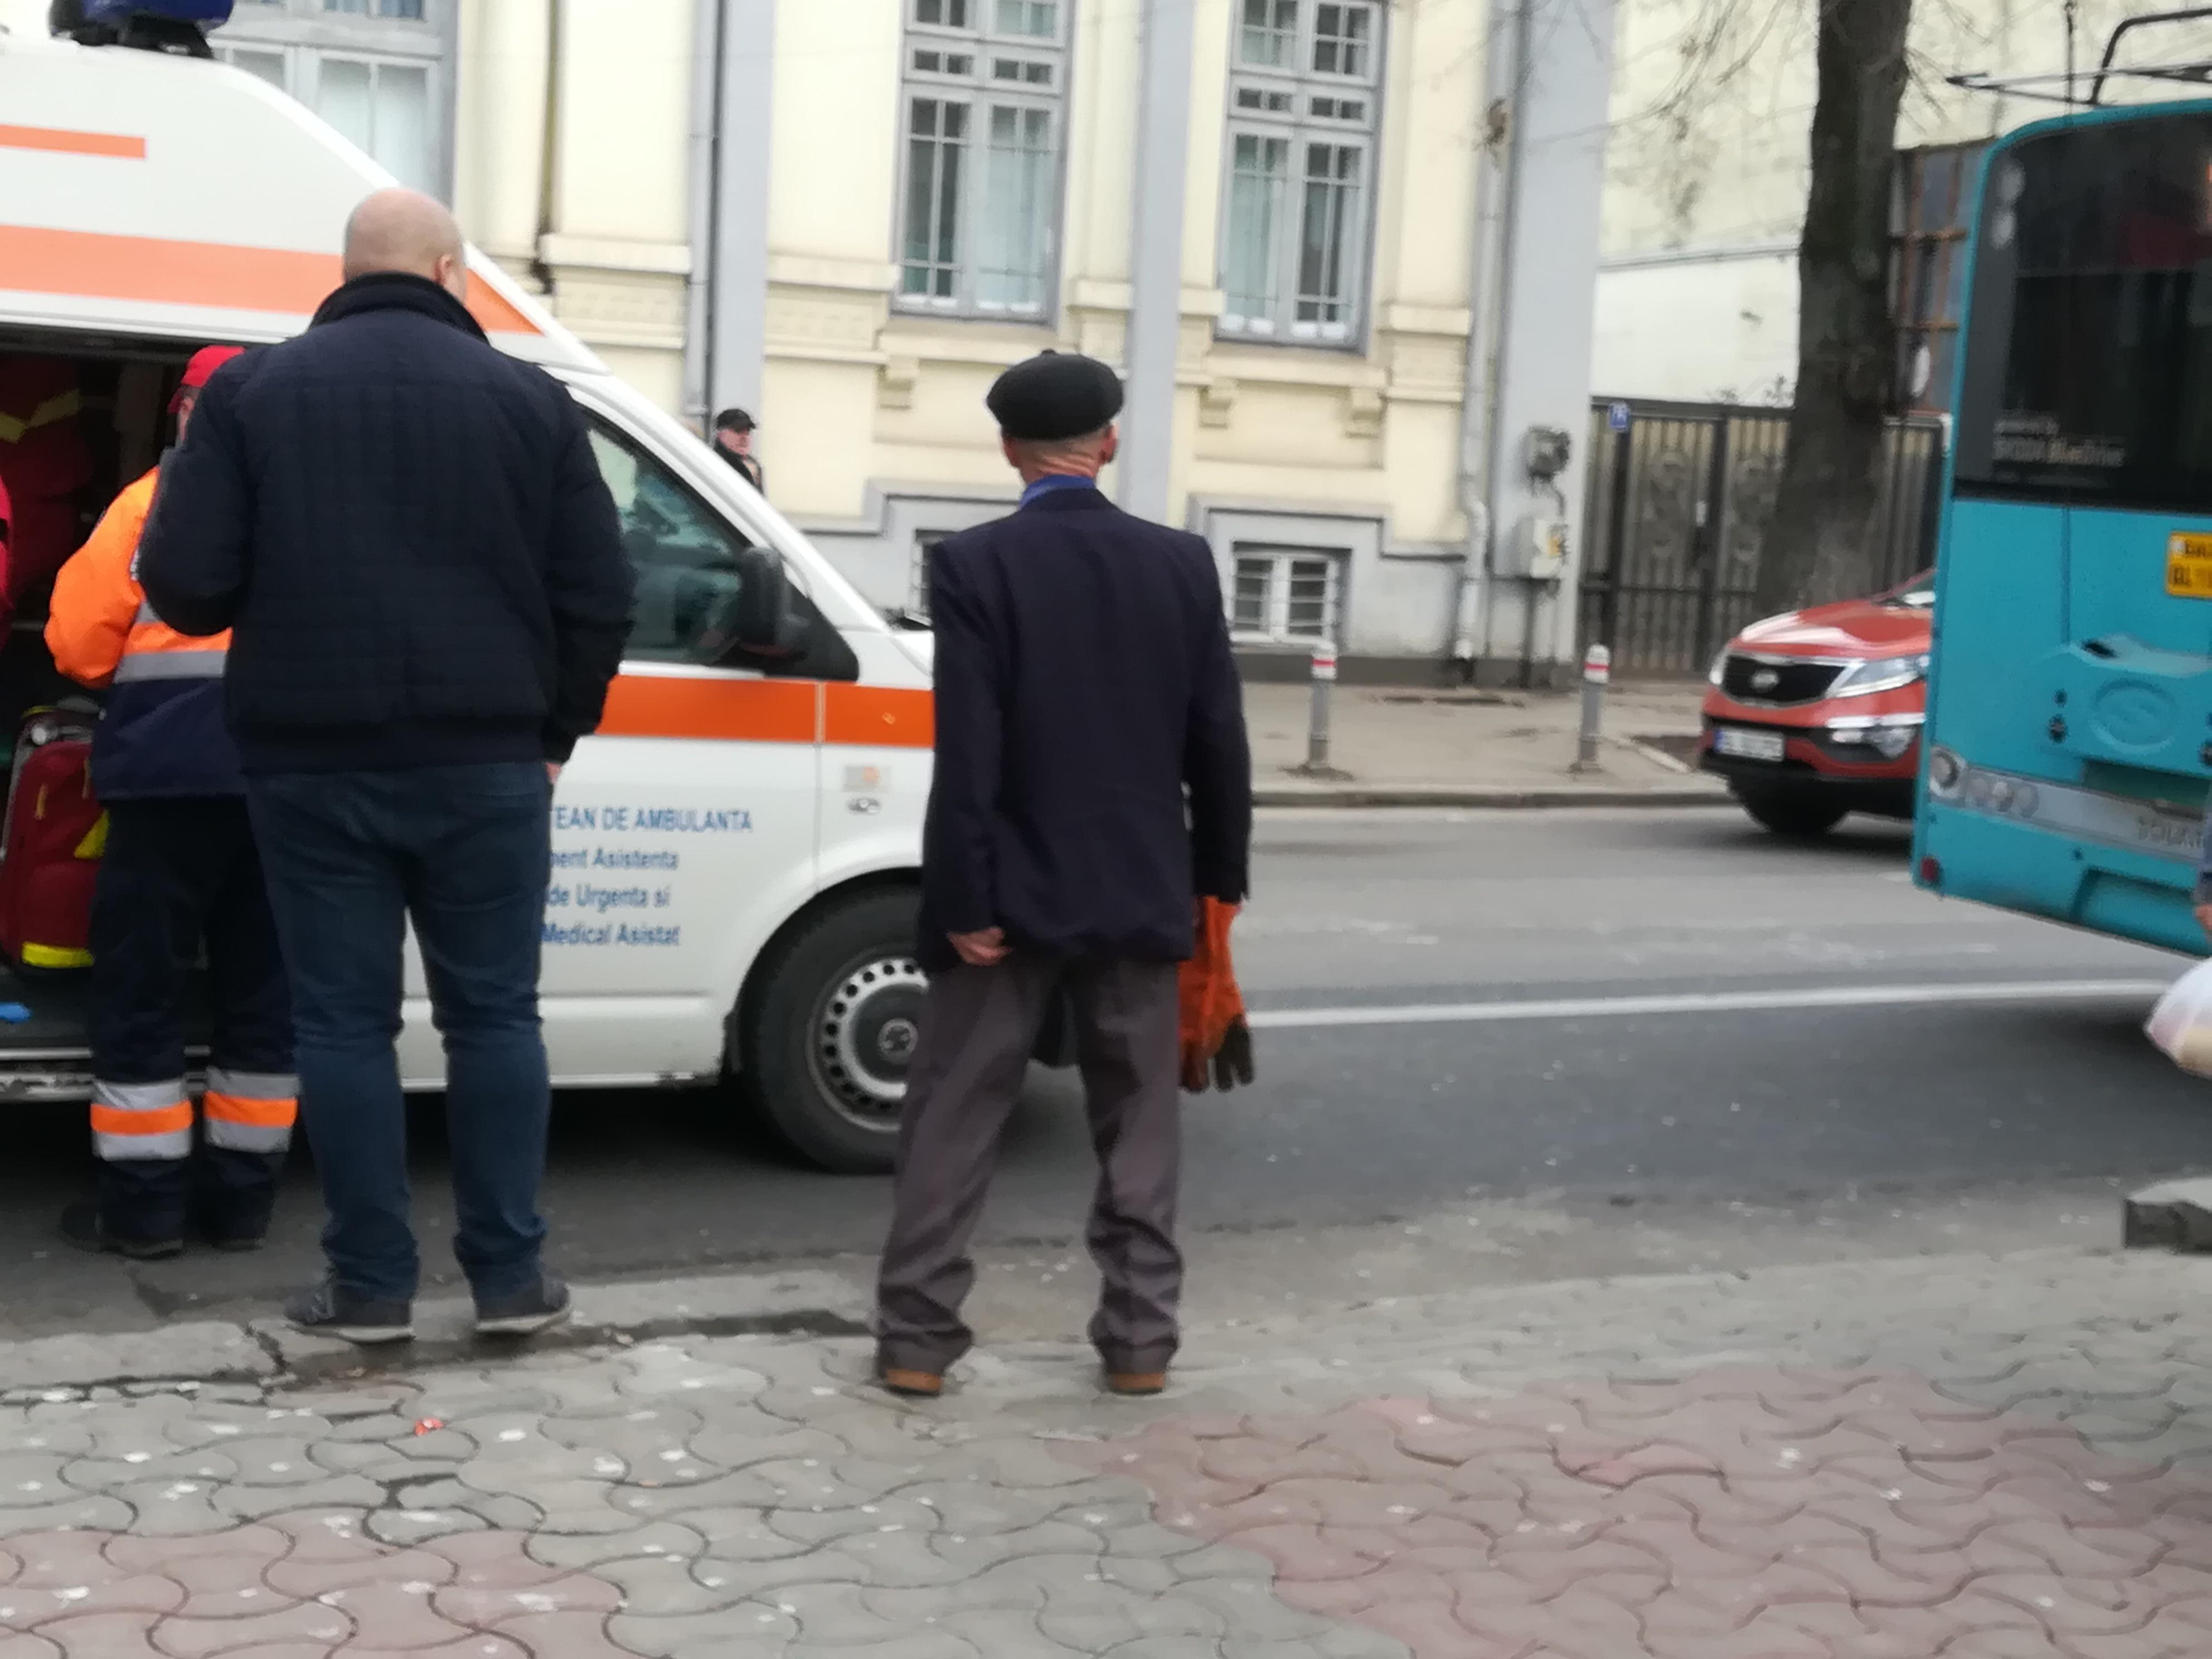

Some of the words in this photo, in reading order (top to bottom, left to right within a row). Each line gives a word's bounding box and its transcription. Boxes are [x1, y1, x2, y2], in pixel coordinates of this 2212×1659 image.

[602, 806, 630, 831] DE
[635, 807, 753, 832] AMBULANTA
[593, 846, 679, 870] Asistenta
[548, 884, 569, 907] de
[576, 883, 648, 914] Urgenta
